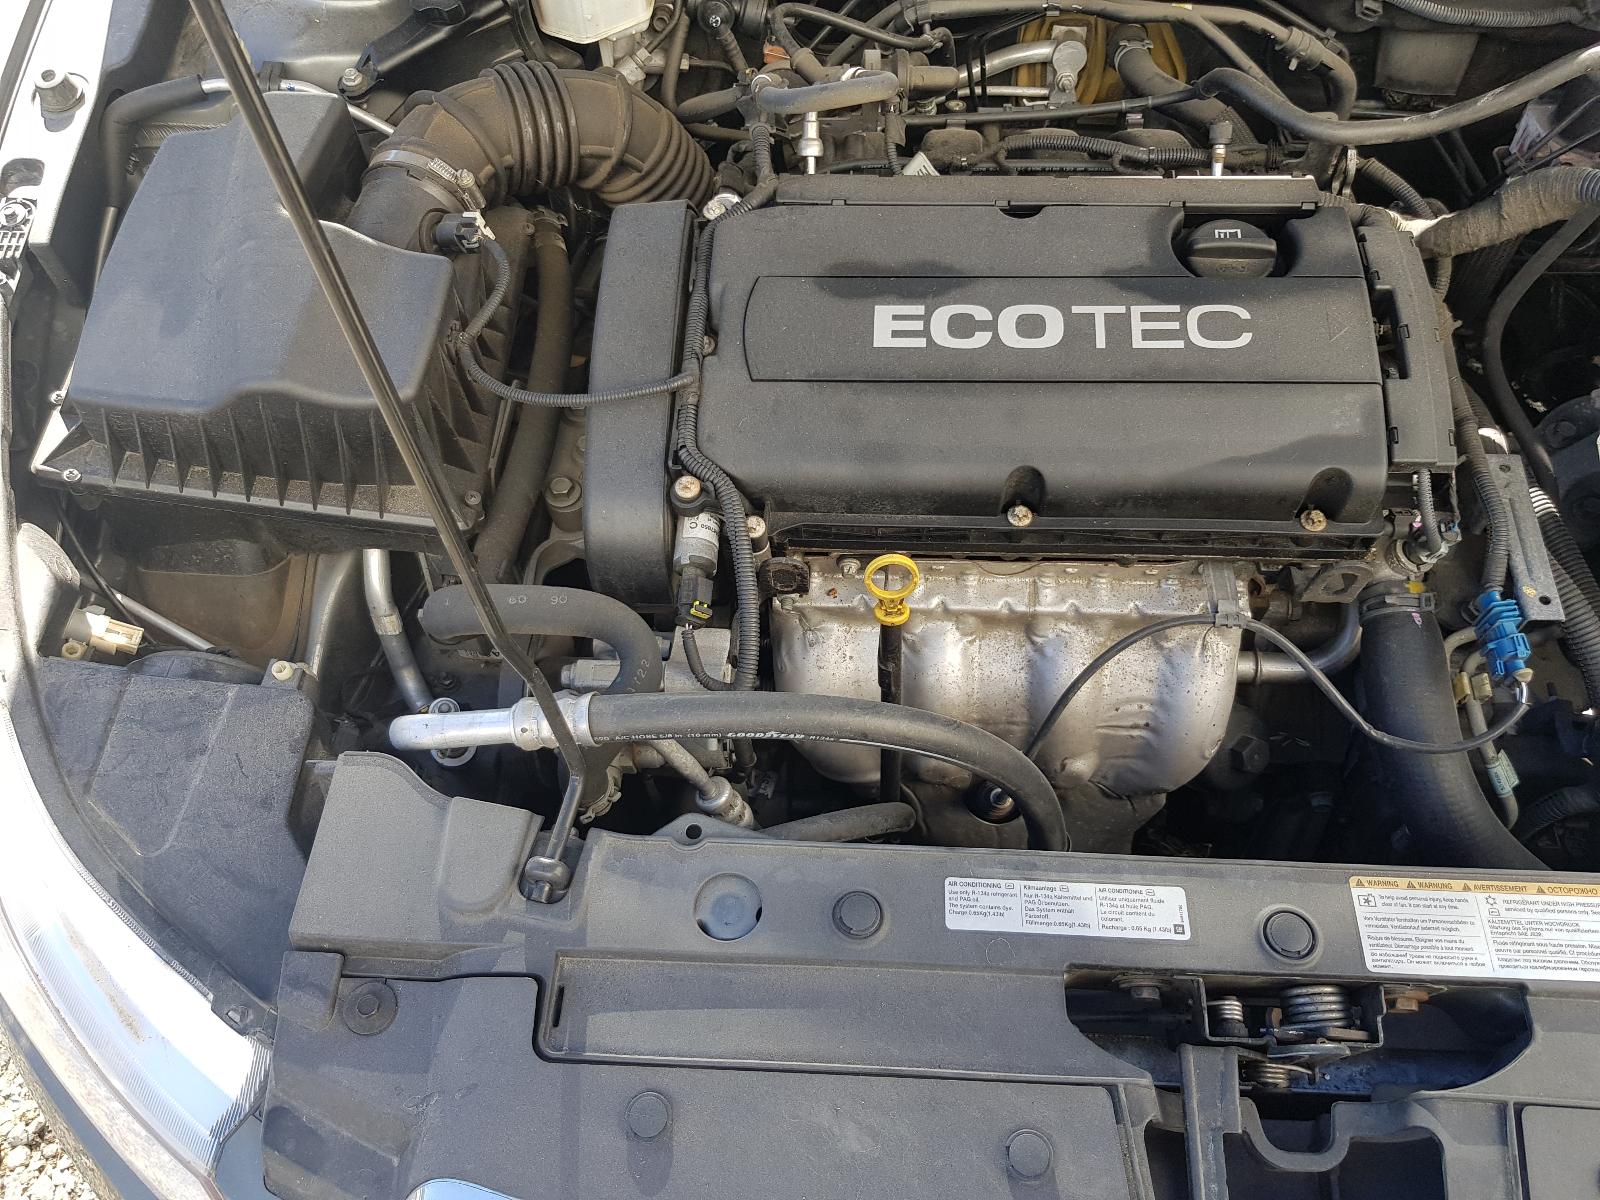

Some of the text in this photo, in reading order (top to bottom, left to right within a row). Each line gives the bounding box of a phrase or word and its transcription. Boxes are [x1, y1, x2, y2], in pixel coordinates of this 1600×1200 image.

[873, 304, 1253, 349] ECOTEC
[551, 596, 568, 605] 90
[727, 730, 805, 739] GOODYEAR
[1366, 880, 1399, 888] WARNING
[1418, 881, 1453, 890] WARNUNG
[1473, 884, 1527, 892] AVERTISSEMENT
